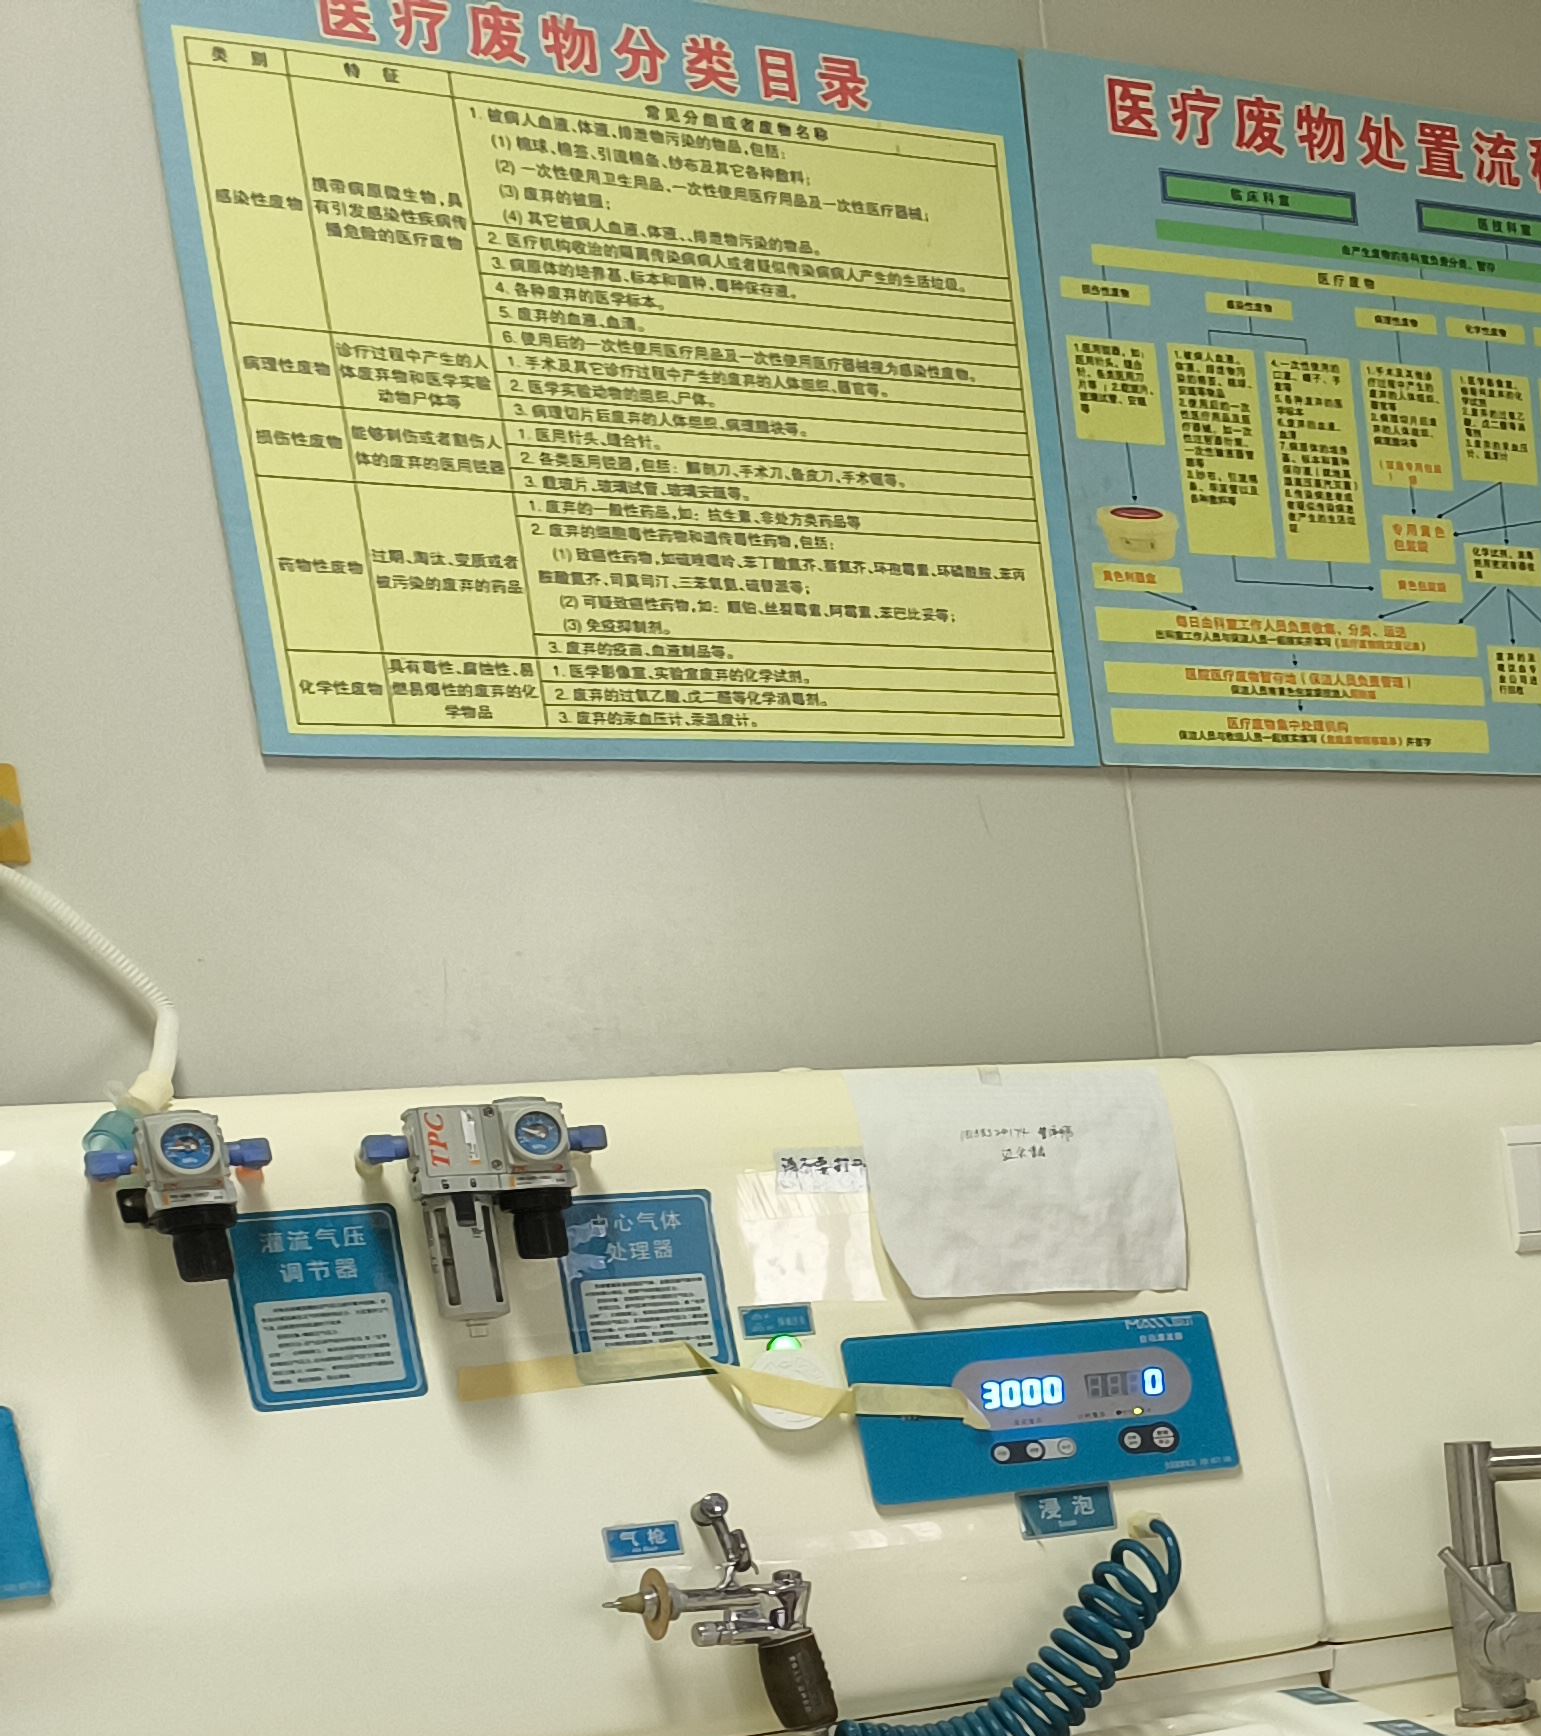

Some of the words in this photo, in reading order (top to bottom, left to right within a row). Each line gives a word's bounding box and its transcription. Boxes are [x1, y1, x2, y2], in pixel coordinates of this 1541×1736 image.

[318, 0, 870, 111] 医疗废物分类目录
[213, 187, 305, 213] 感染性废物
[241, 354, 333, 377] 病理性废物
[276, 557, 366, 576] 药物性废物
[297, 679, 386, 697] 化学性废物
[423, 1111, 451, 1168] TPC
[604, 1238, 674, 1263] 处理器
[279, 1257, 360, 1284] 调节器
[980, 1374, 1066, 1411] 3000
[1038, 1495, 1097, 1520] 浸泡
[618, 1527, 669, 1547] 气枪
